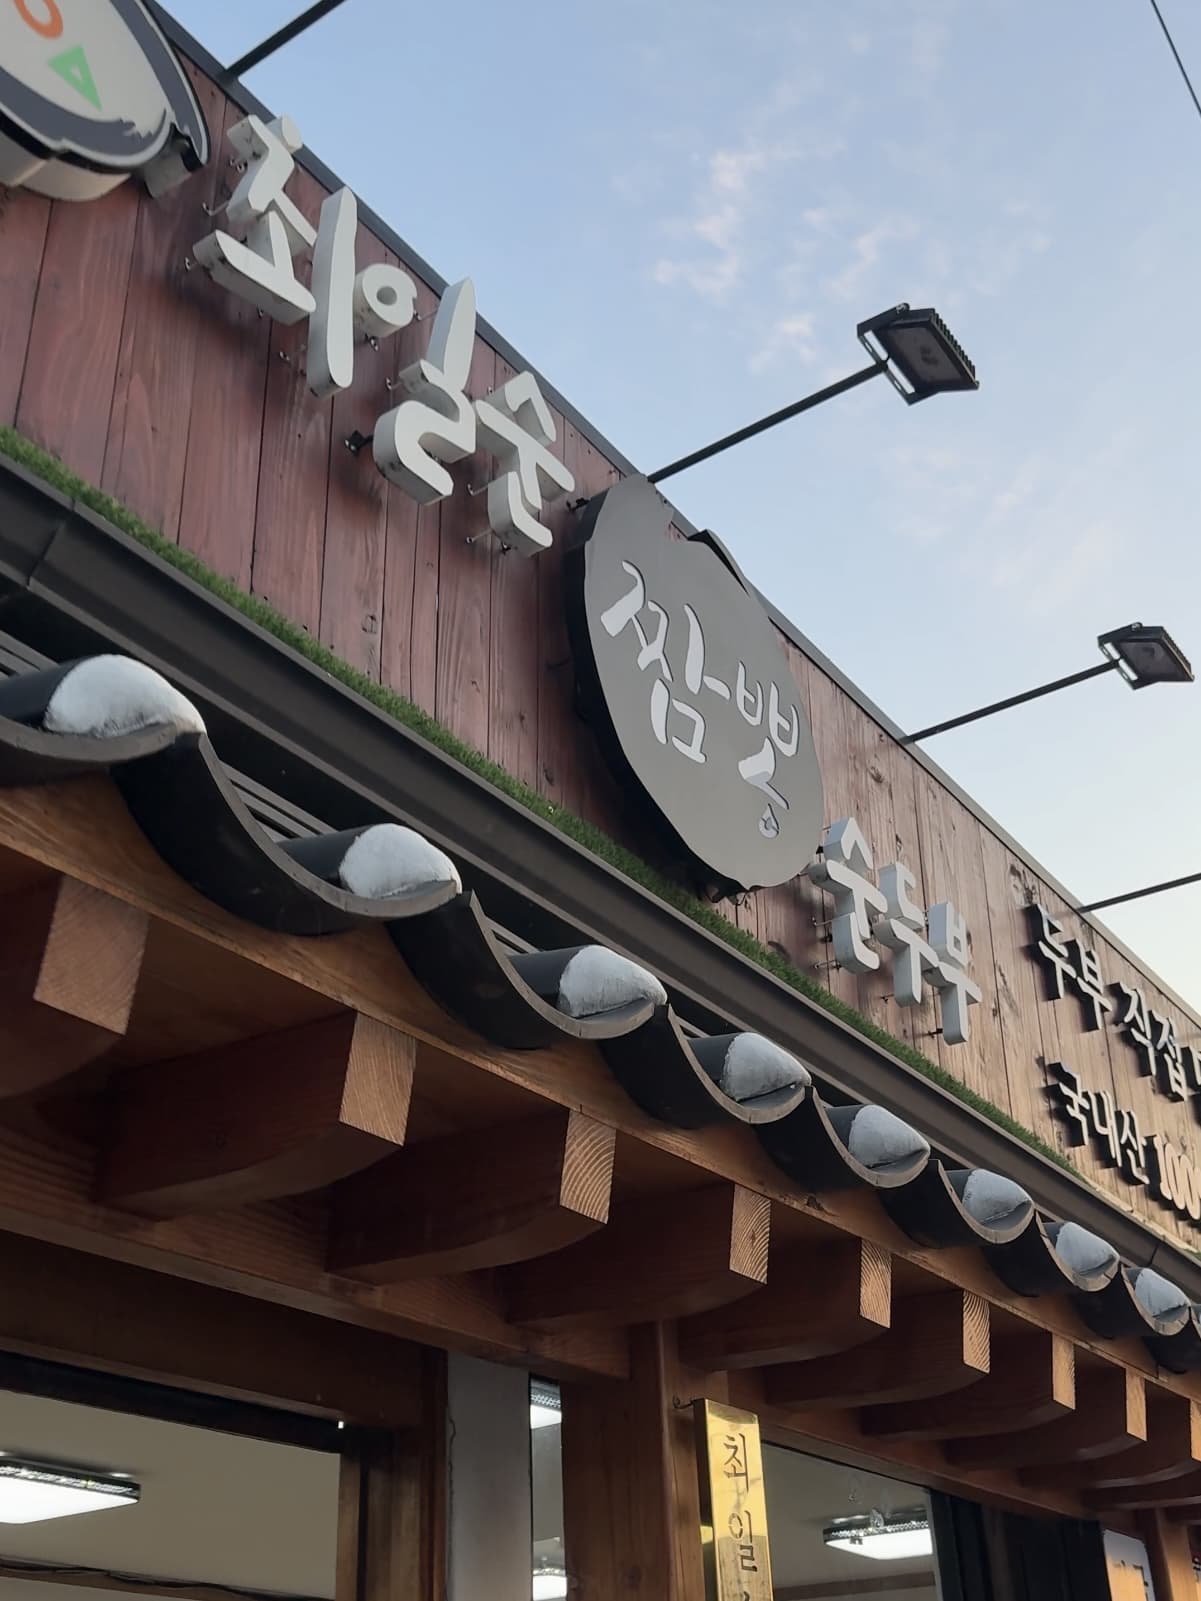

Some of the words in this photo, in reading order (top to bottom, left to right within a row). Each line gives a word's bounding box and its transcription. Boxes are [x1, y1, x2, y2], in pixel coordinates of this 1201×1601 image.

[200, 113, 575, 548] 최일순
[601, 560, 800, 839] 짬뽕
[818, 817, 983, 1045] 순두부
[1036, 903, 1112, 1031] 두부
[1119, 981, 1188, 1102] 직접
[1056, 1062, 1150, 1185] 국내산
[1153, 1133, 1201, 1220] 100
[723, 1432, 758, 1601] 최일
